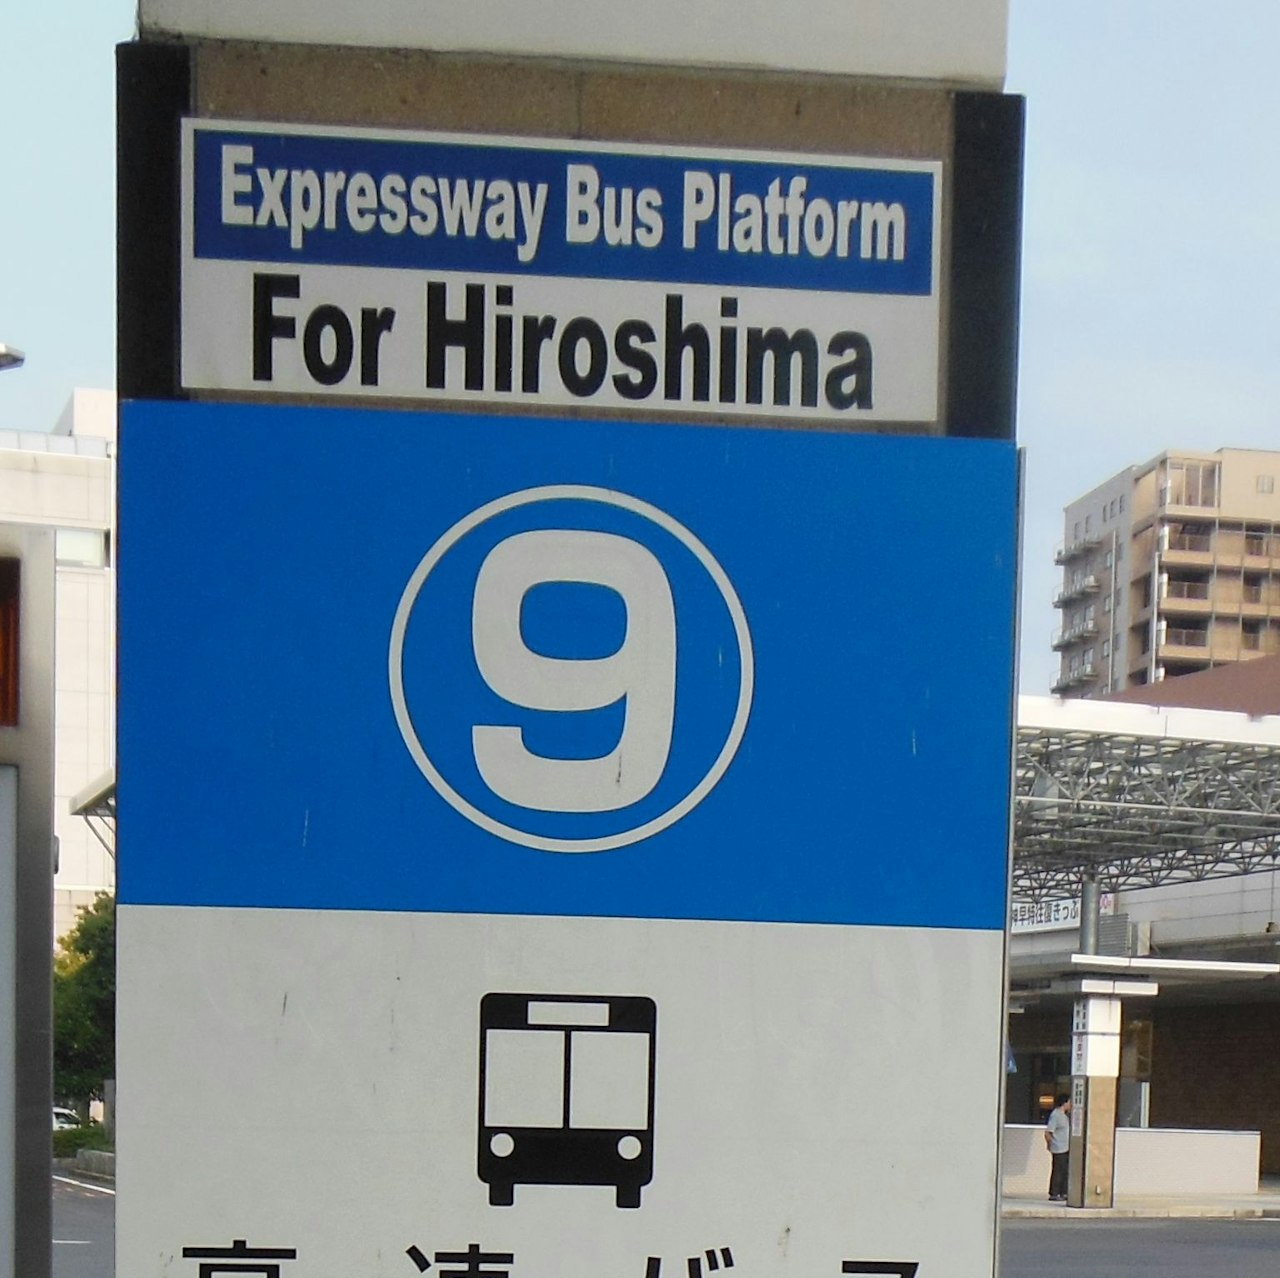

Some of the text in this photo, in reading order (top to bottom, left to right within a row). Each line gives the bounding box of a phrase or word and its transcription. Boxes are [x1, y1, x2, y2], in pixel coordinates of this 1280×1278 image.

[221, 145, 907, 262] Expressway Bus Platform
[252, 273, 875, 411] For Hiroshima
[472, 529, 677, 813] 9
